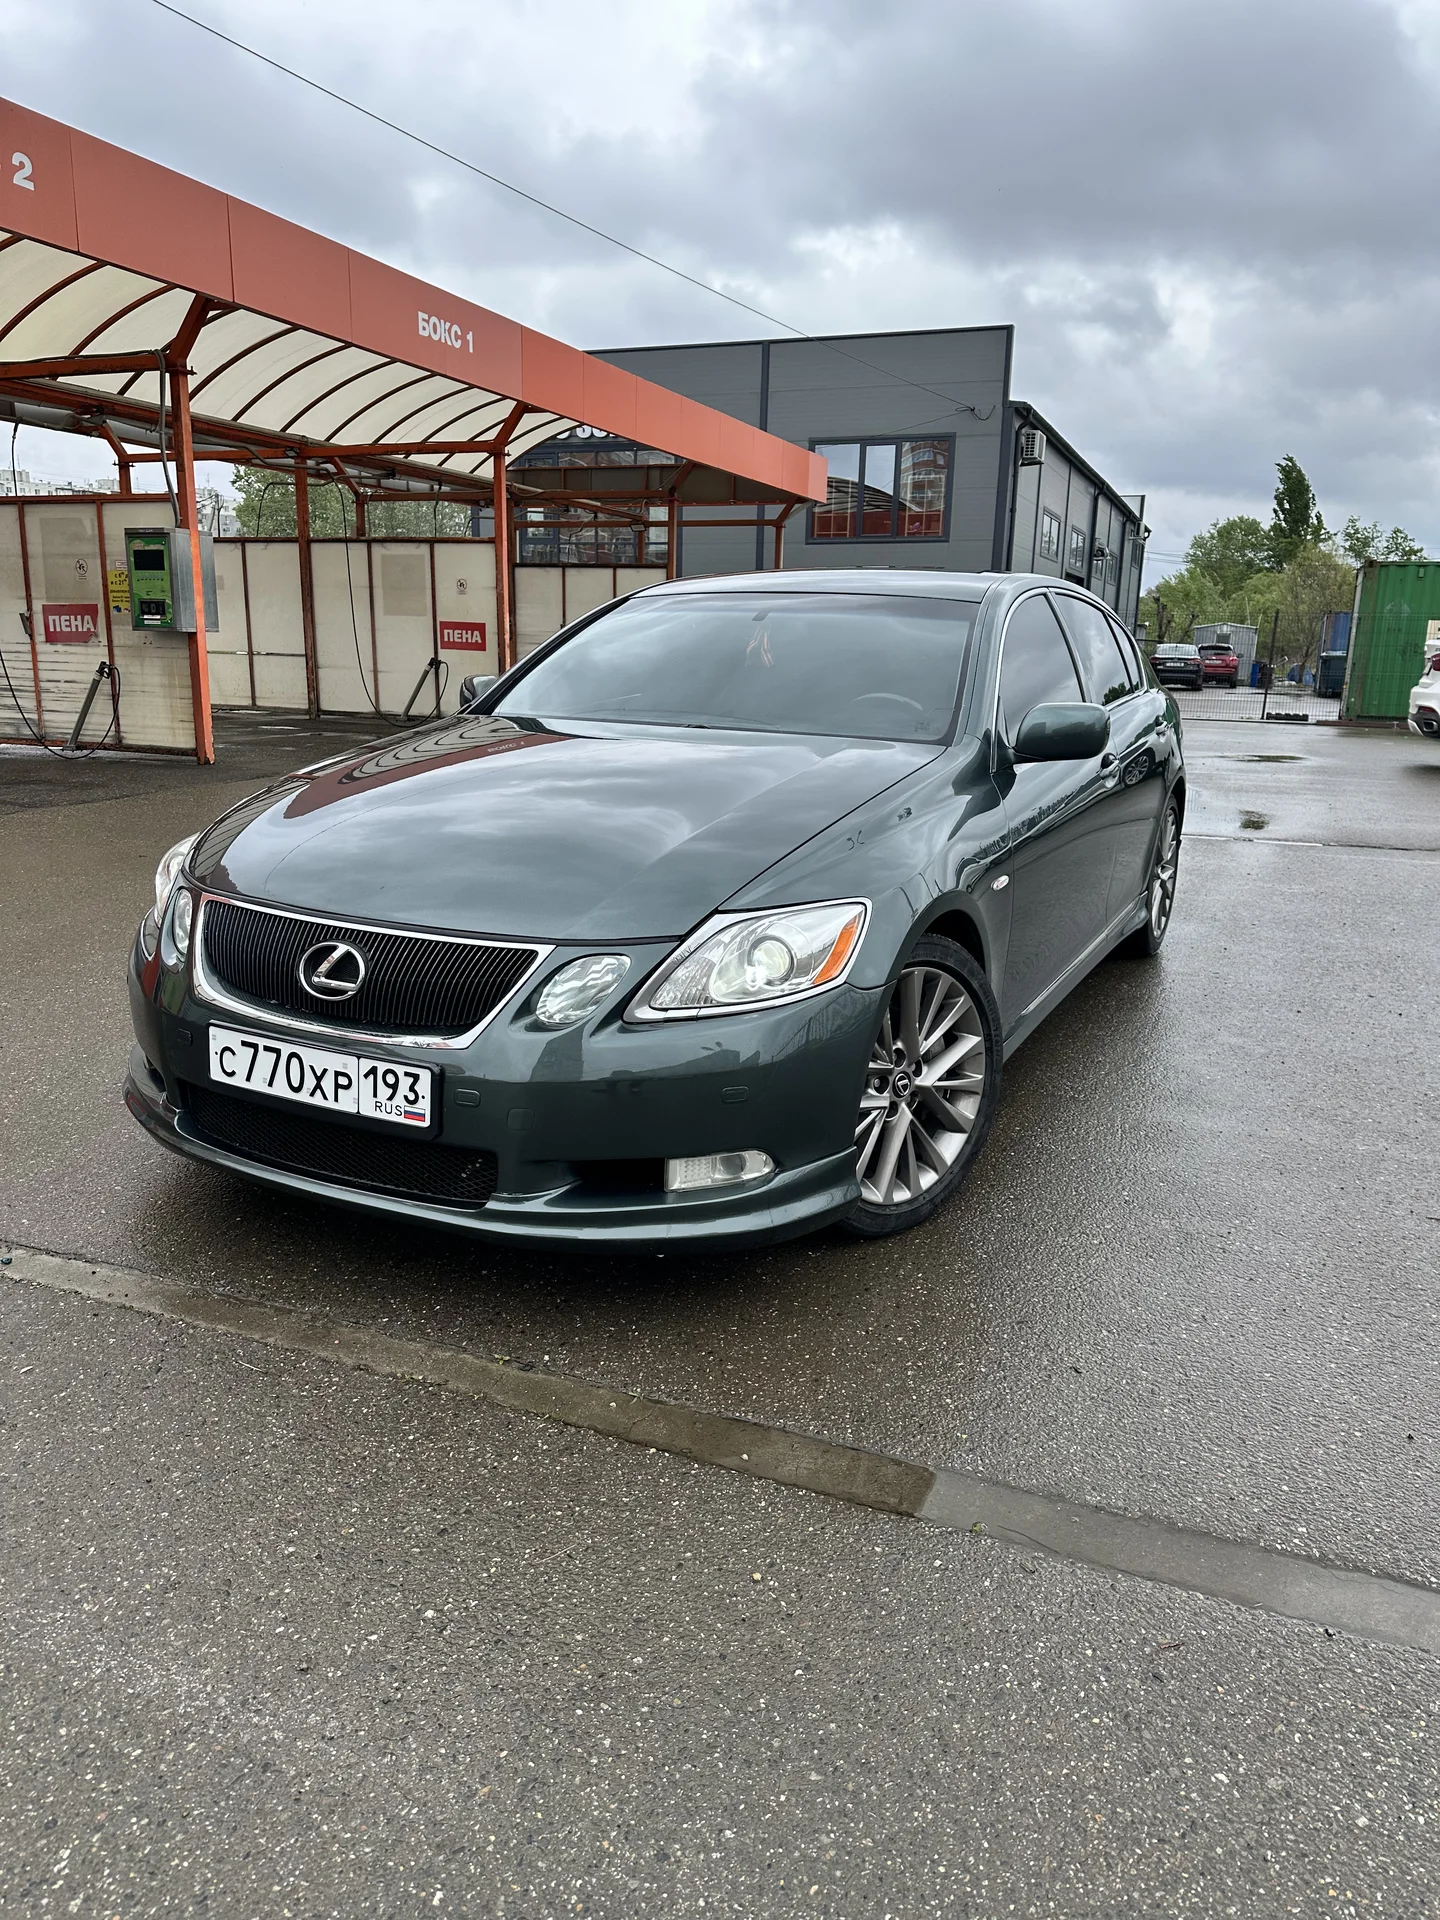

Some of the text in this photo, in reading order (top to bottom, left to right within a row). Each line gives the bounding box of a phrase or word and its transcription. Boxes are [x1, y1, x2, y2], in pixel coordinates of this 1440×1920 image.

[12, 152, 35, 191] 2
[417, 310, 473, 353] БОКС 1
[48, 615, 95, 632] ПЕНА
[443, 629, 482, 643] ПЕНА
[219, 1039, 420, 1105] С770ХР 193
[374, 1100, 403, 1117] RUS
